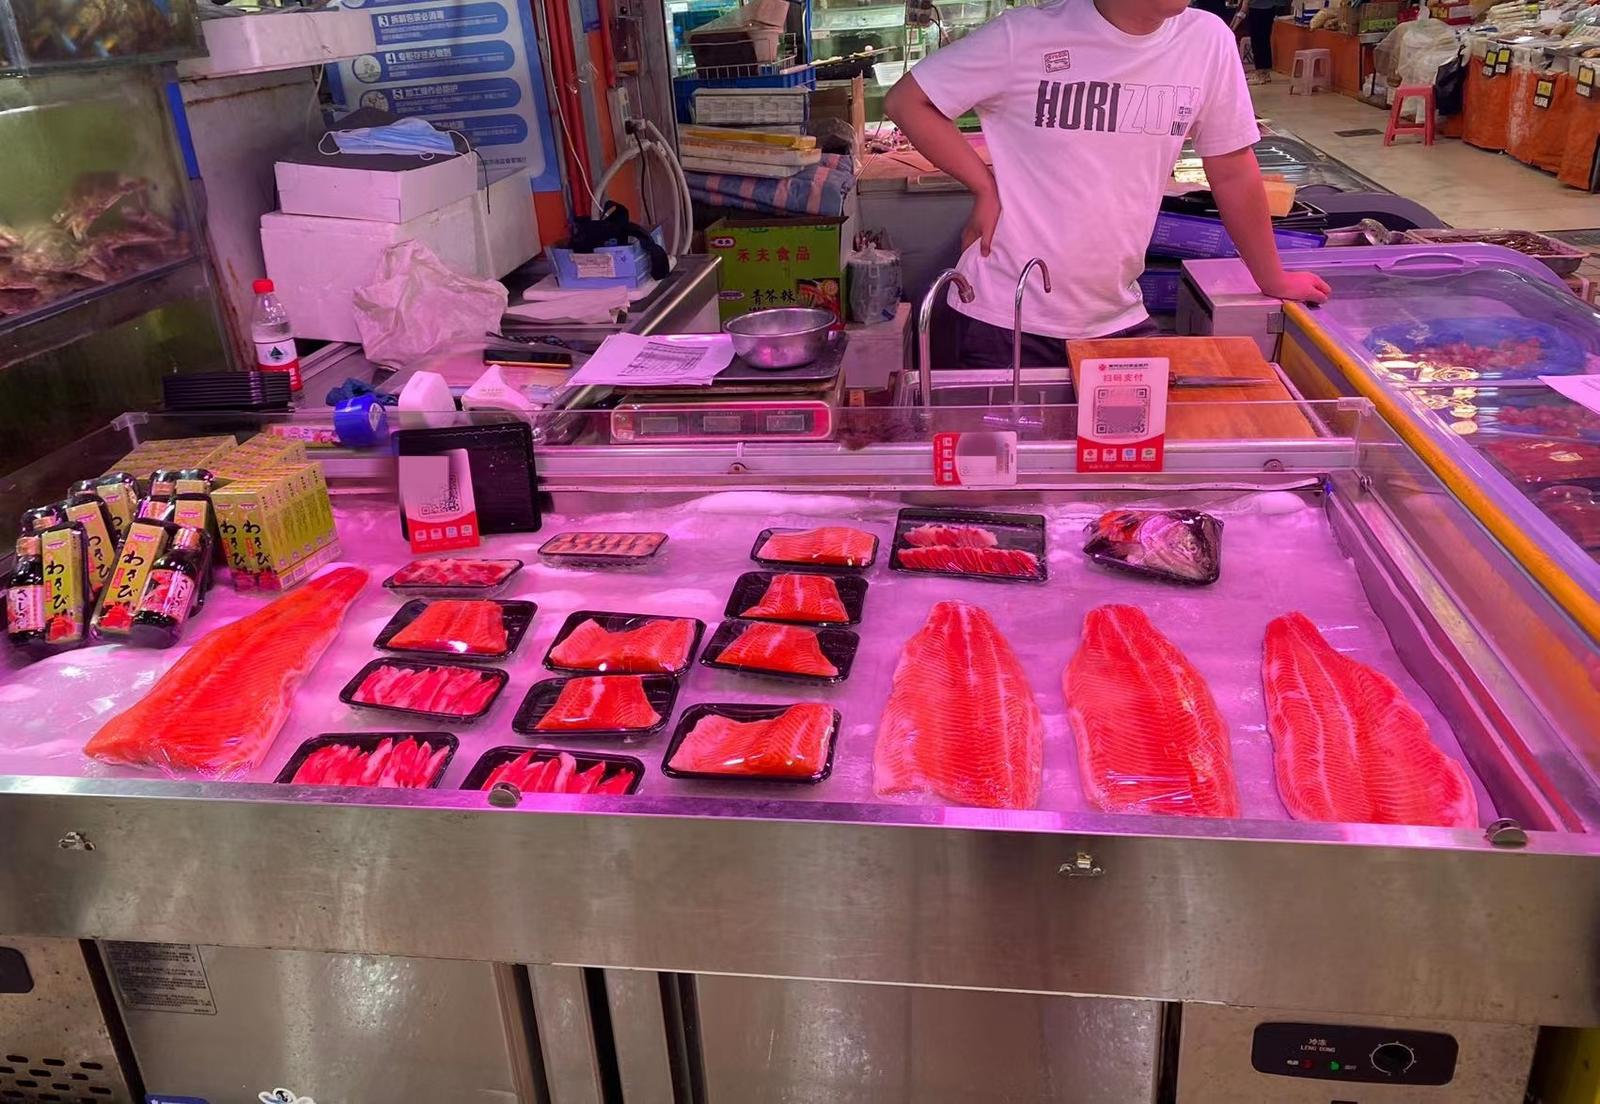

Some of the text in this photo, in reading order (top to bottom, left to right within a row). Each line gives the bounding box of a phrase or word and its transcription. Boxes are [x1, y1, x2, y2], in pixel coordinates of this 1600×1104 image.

[1103, 373, 1143, 382] 扫码支付
[243, 519, 271, 566] わさび
[45, 560, 70, 610] わさび
[117, 550, 144, 599] わさび
